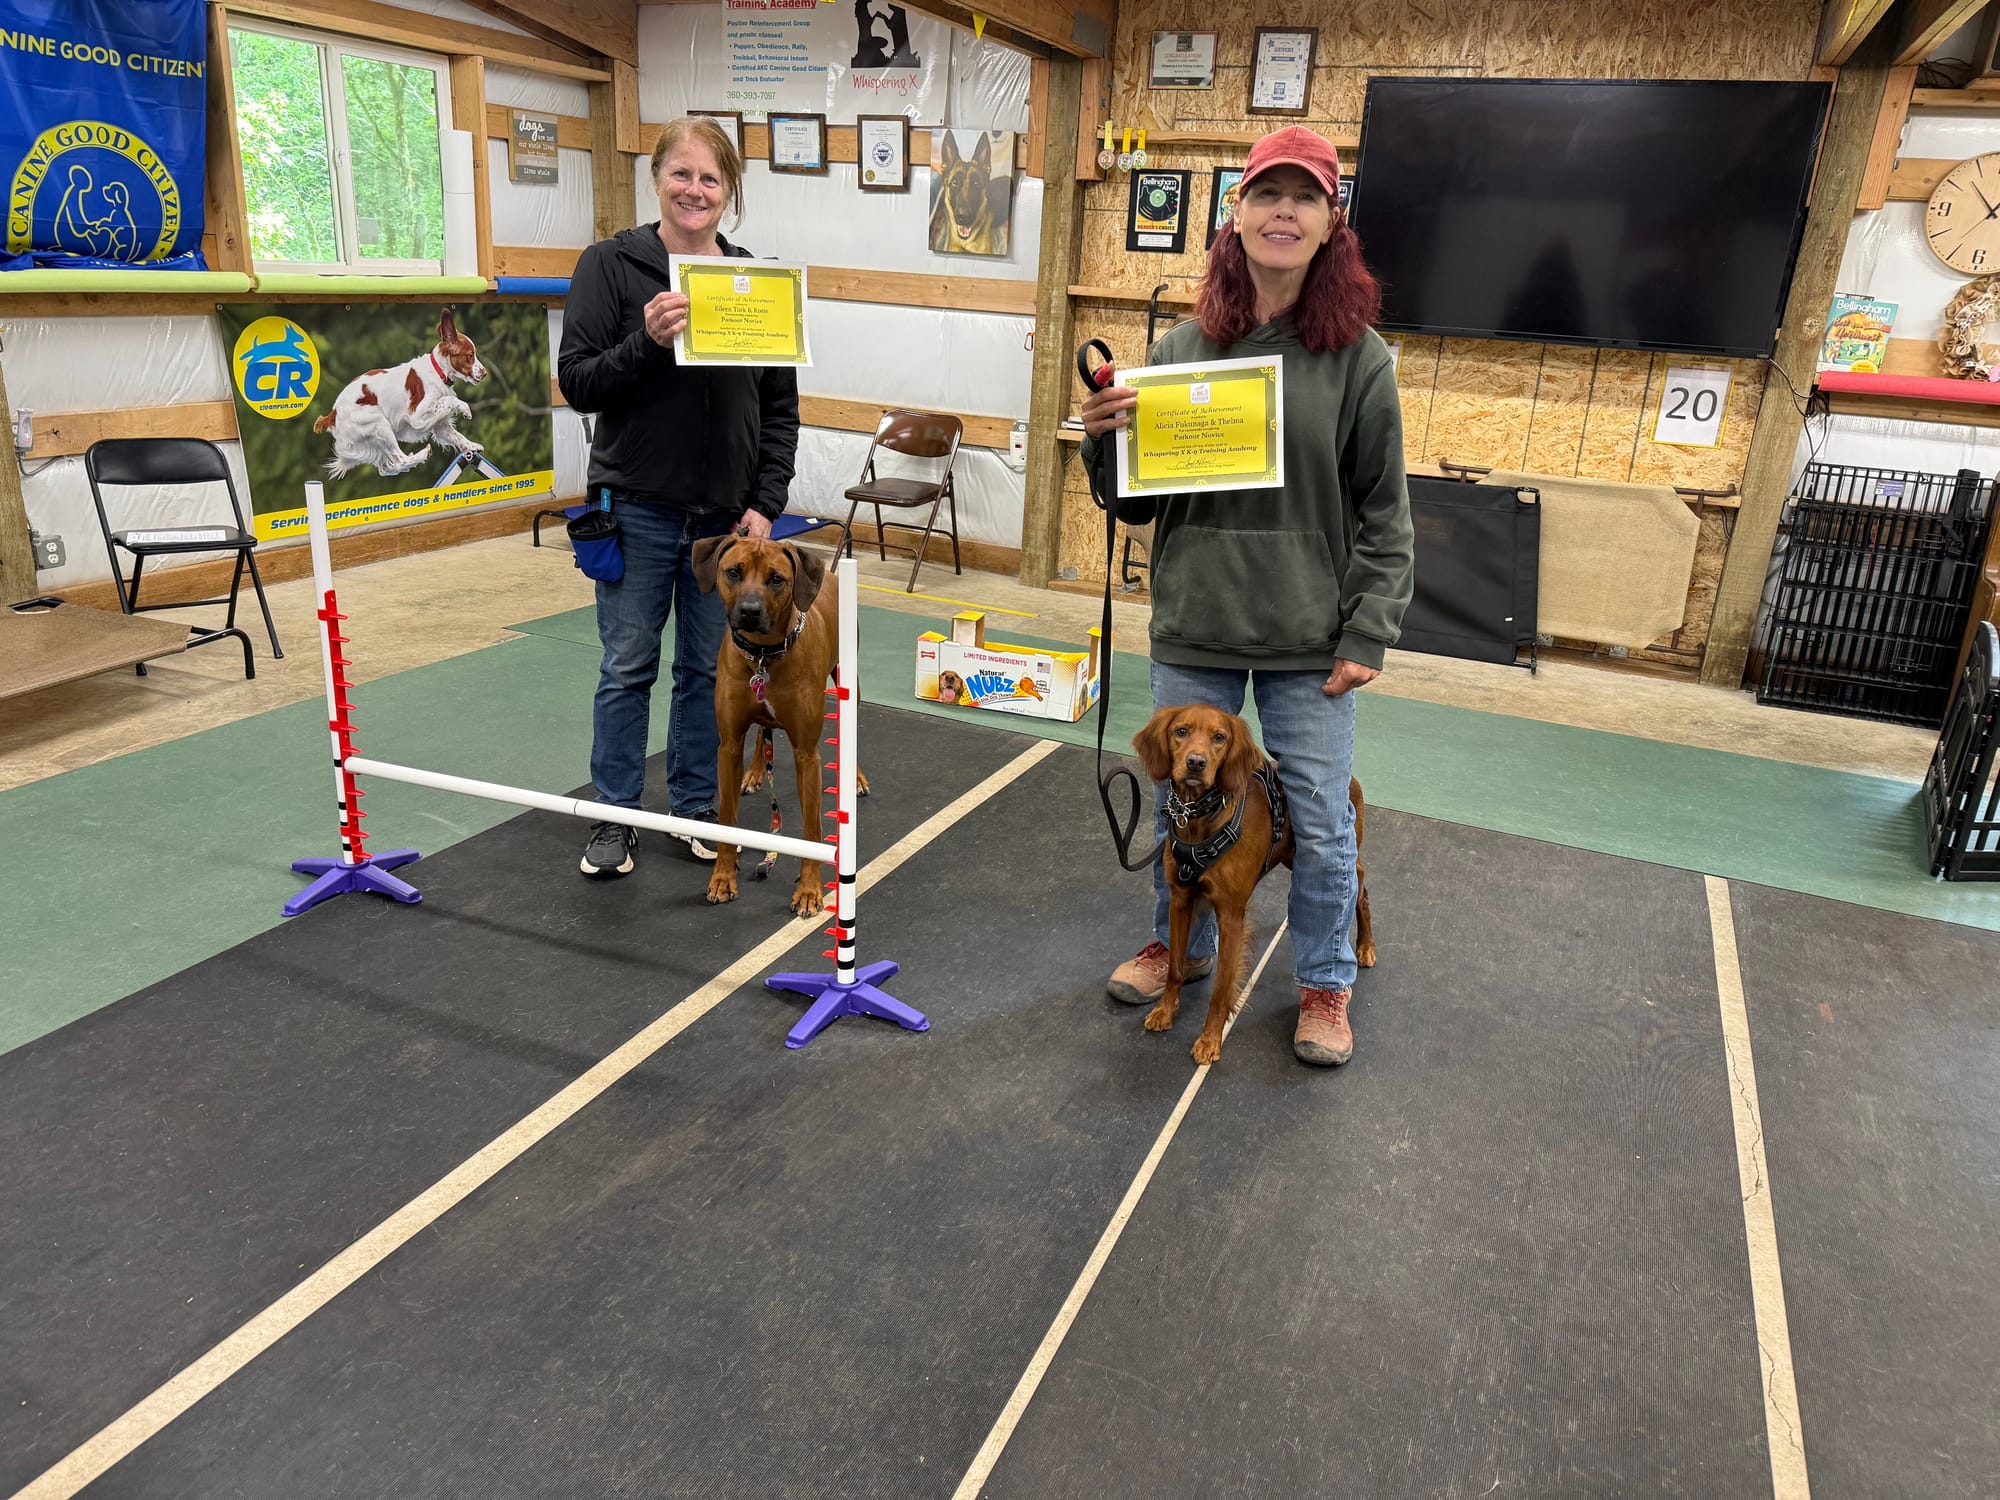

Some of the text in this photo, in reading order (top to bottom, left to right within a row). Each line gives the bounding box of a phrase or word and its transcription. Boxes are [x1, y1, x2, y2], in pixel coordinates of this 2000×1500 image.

[727, 0, 816, 10] Training Academy
[60, 42, 121, 66] GOOD
[853, 73, 918, 96] Whispering X
[726, 91, 776, 100] 360-393-7097
[519, 114, 545, 141] dogs
[11, 125, 177, 244] CANINE GOOD CITIZEN
[1143, 178, 1176, 187] Bellingham
[1938, 202, 1951, 216] 9
[1972, 249, 1986, 264] 6
[1836, 300, 1891, 314] Bellingham
[244, 361, 312, 401] CR
[1156, 408, 1190, 417] Certificate
[1665, 387, 1718, 422] 20
[326, 501, 400, 522] performance
[403, 497, 429, 509] dogs
[433, 494, 440, 503] &
[443, 487, 487, 502] handlers
[490, 483, 512, 493] since
[515, 479, 535, 490] 1995
[964, 652, 1027, 667] LIMITED INGREDIENTS
[966, 674, 1015, 699] NUBZ
